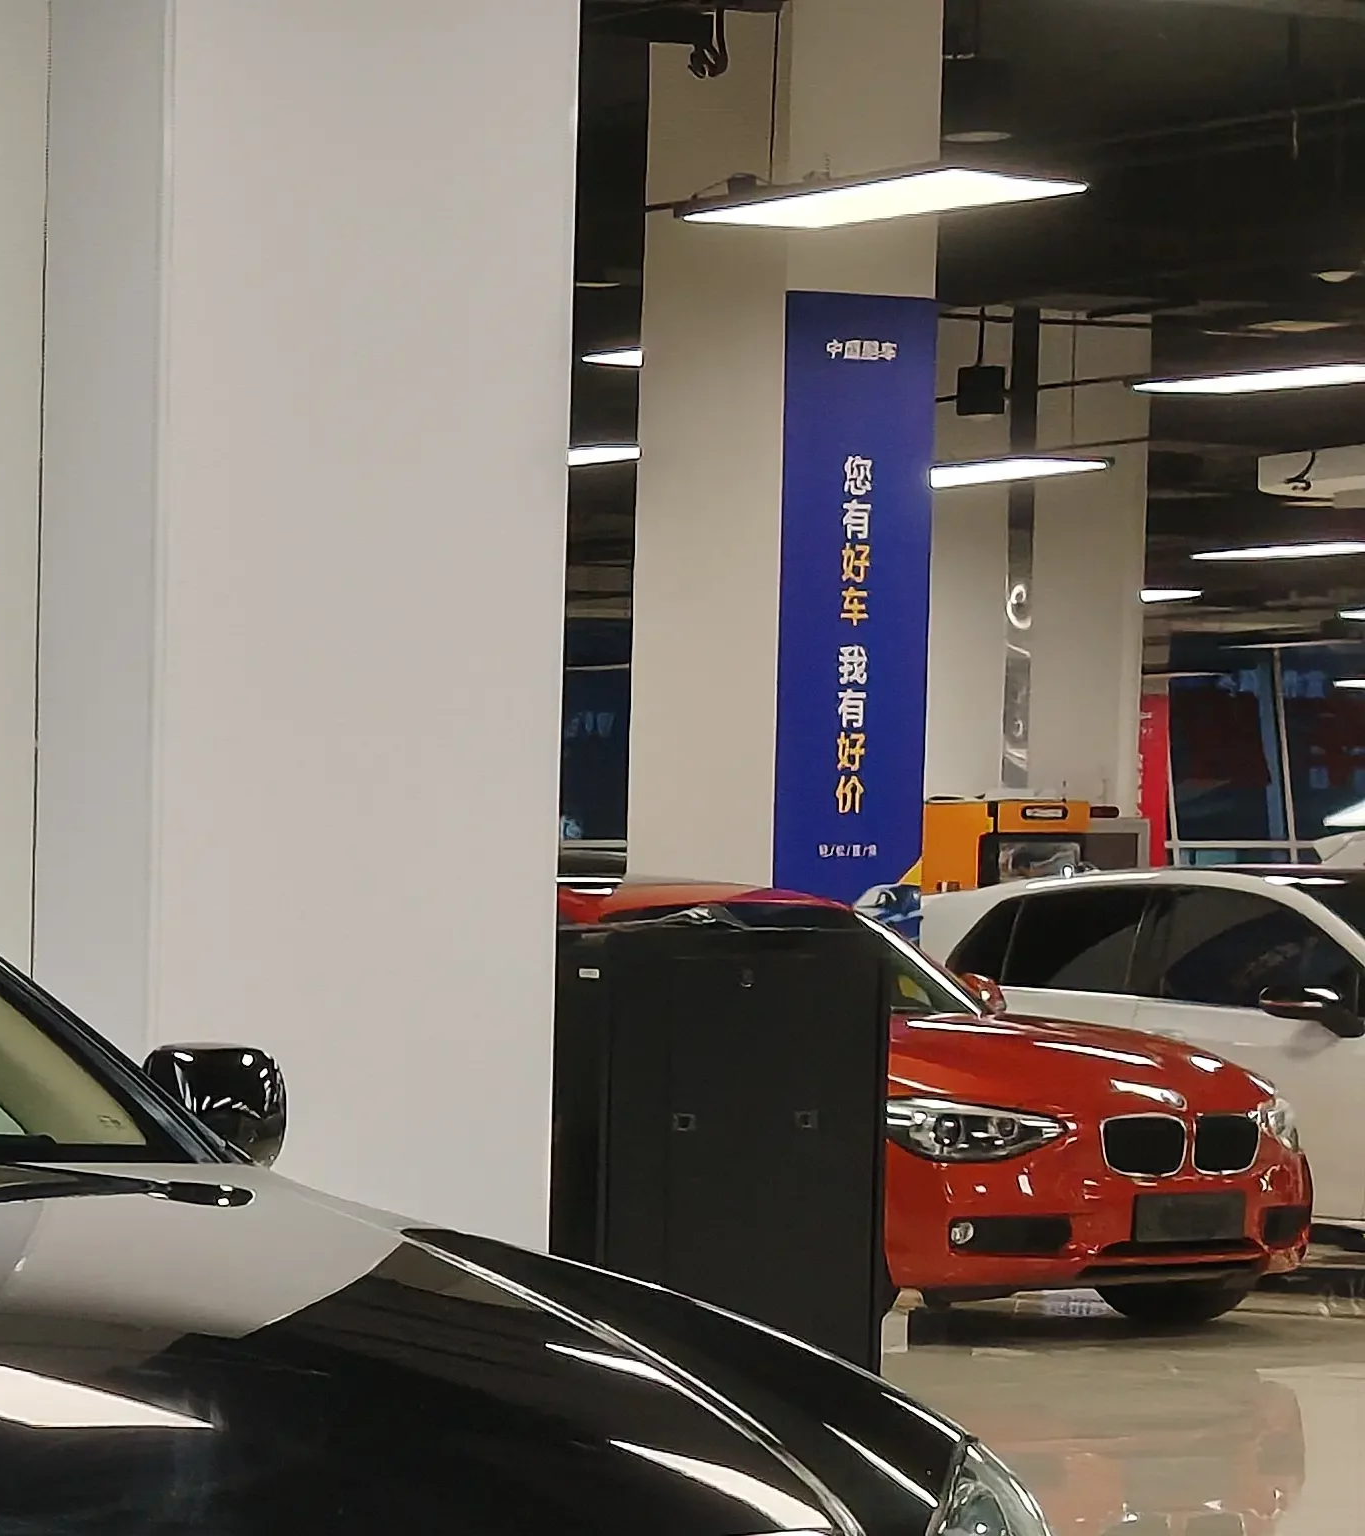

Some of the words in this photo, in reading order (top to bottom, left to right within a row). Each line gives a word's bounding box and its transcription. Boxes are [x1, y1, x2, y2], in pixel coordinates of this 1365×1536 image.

[840, 455, 874, 627] 您有好车
[835, 645, 869, 815] 我有好价
